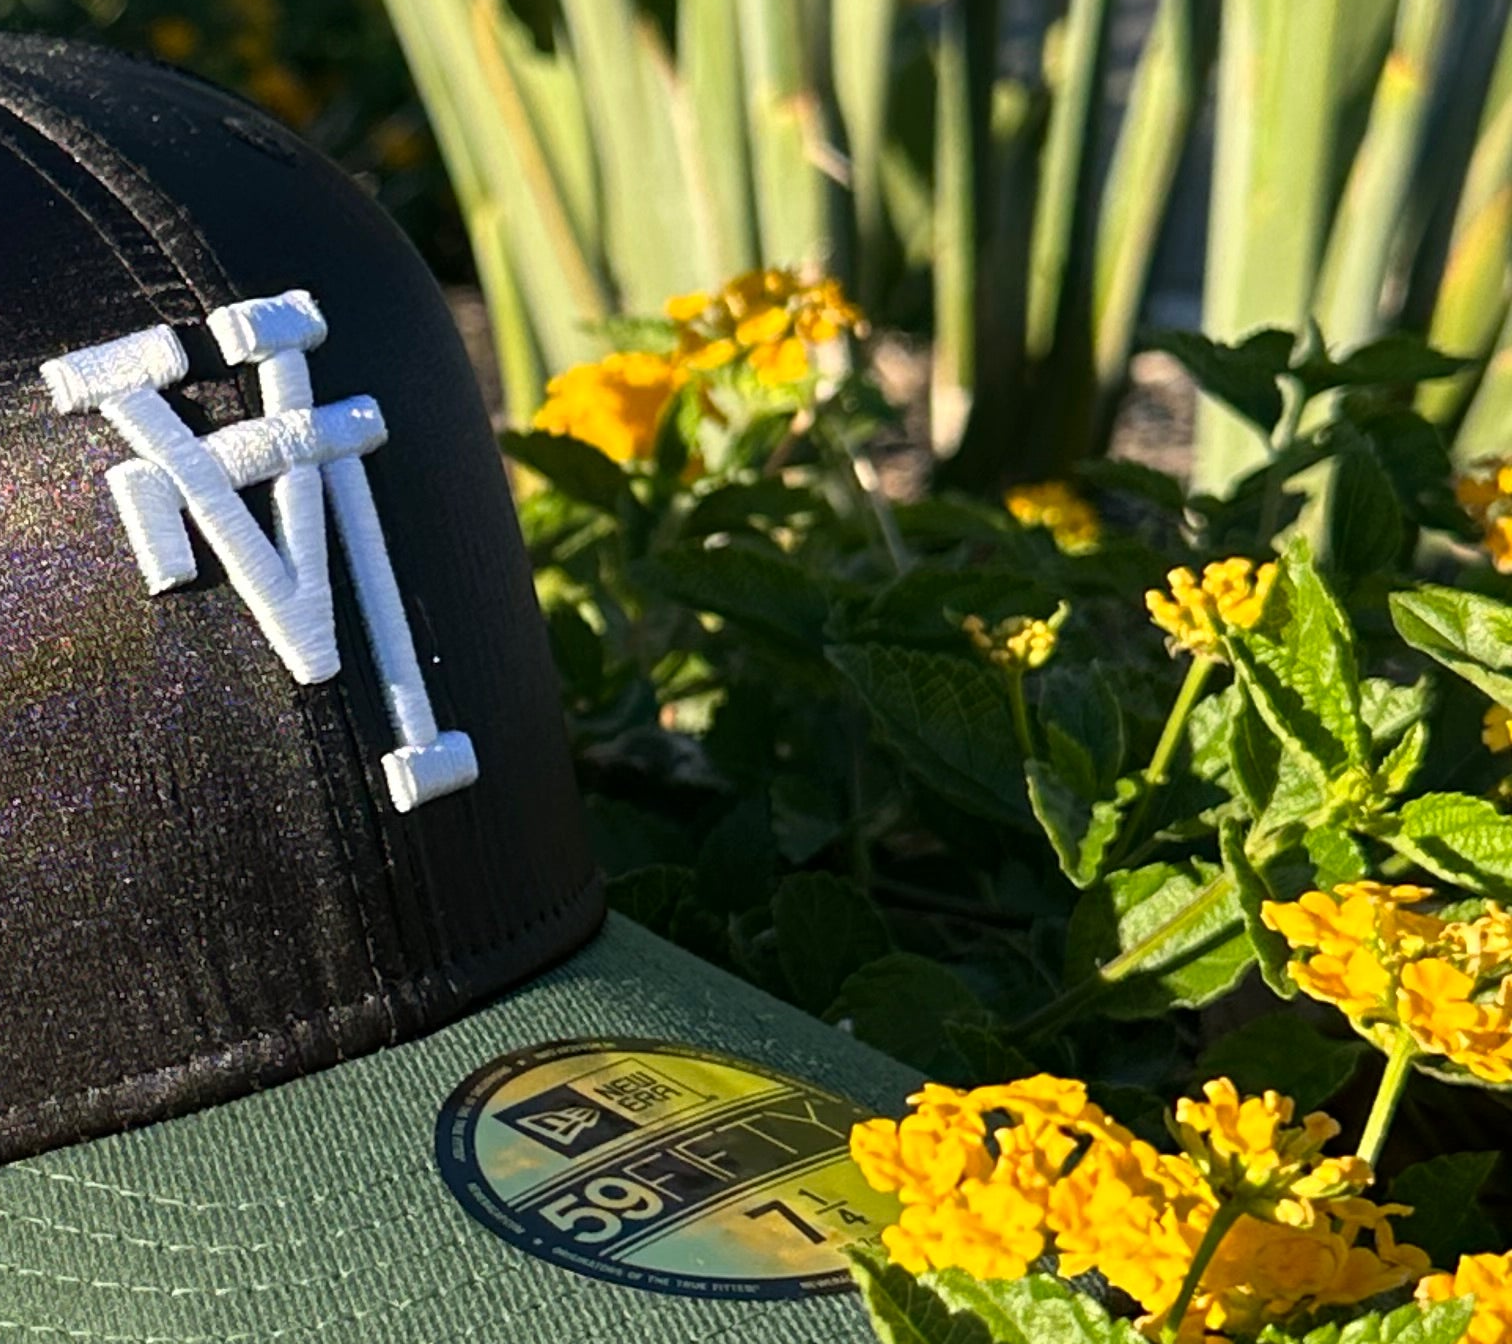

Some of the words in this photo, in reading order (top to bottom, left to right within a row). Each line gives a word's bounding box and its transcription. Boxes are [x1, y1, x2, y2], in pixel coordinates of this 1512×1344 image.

[592, 1071, 658, 1099] NEW
[618, 1084, 687, 1112] ERA
[538, 1099, 850, 1244] 59FIFTY
